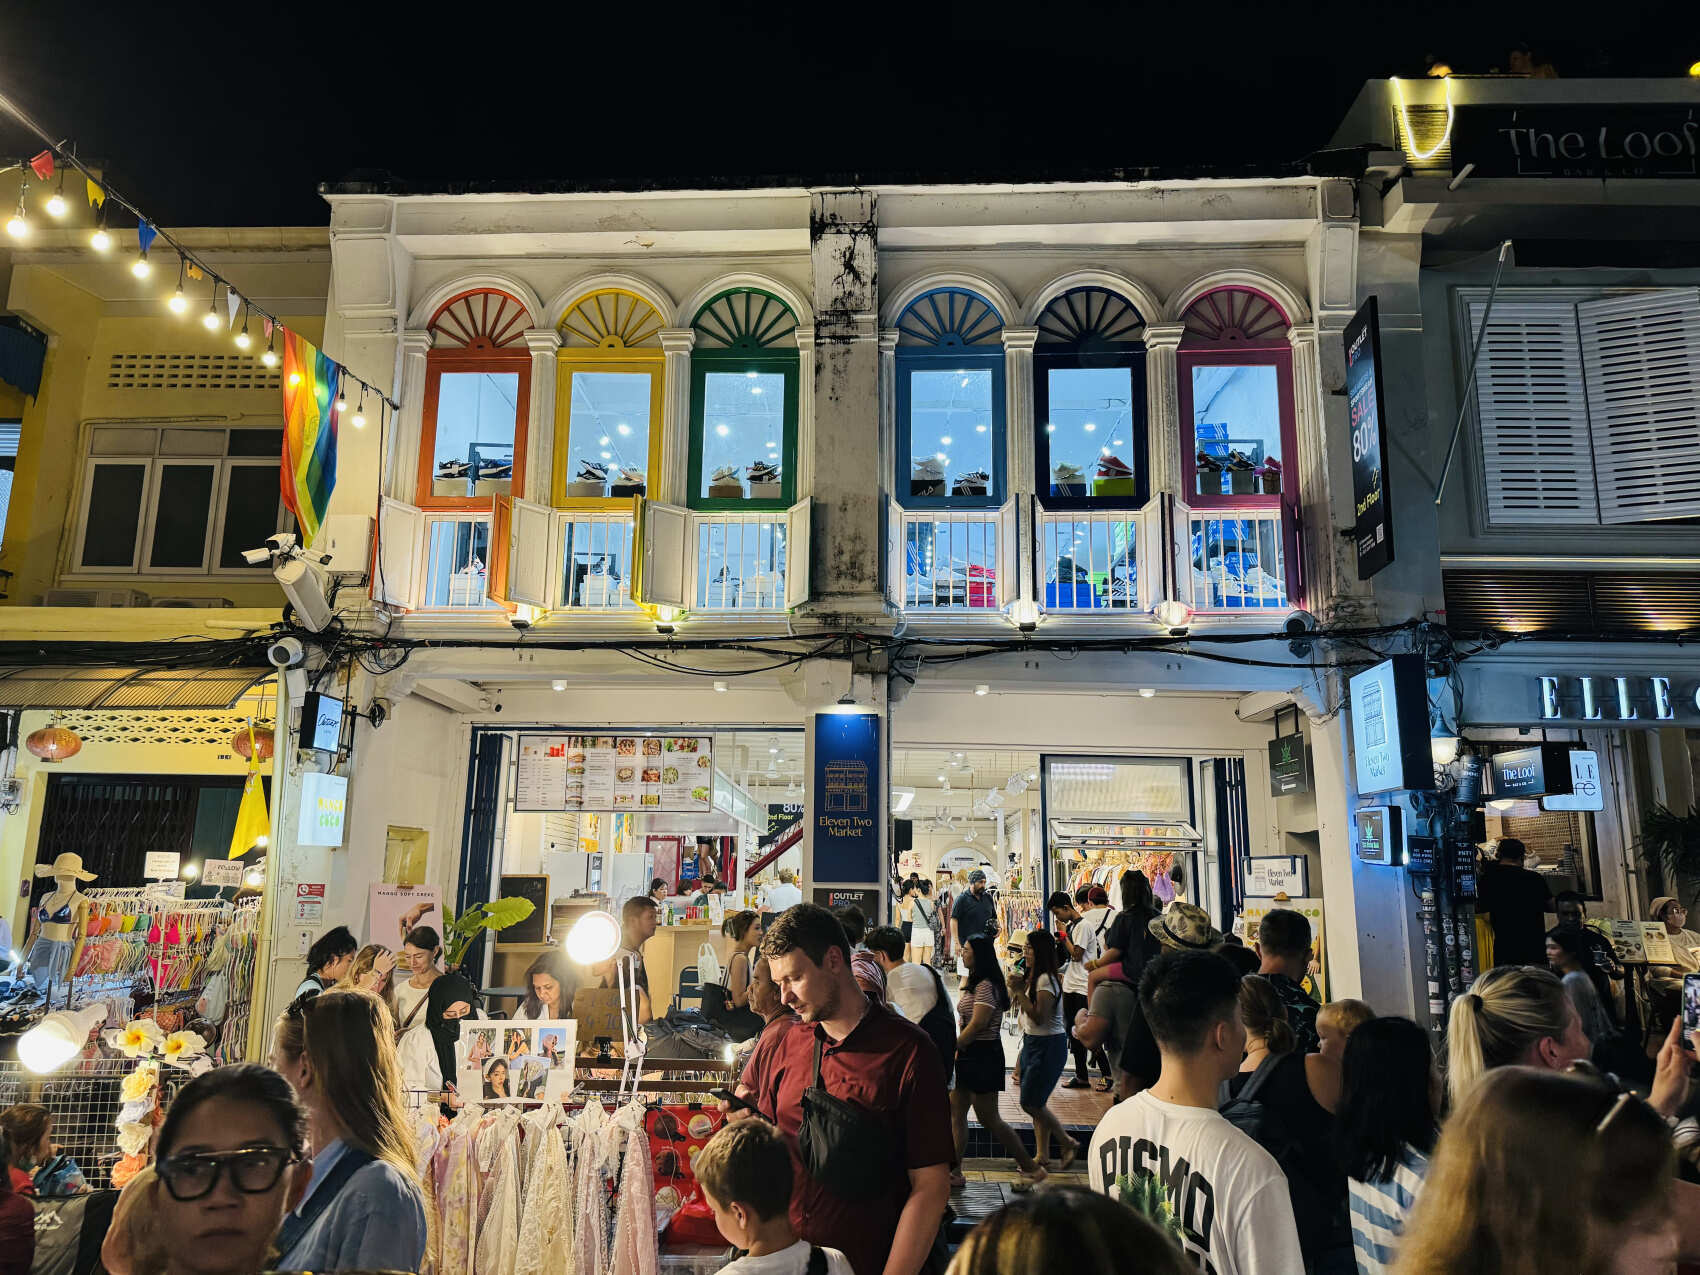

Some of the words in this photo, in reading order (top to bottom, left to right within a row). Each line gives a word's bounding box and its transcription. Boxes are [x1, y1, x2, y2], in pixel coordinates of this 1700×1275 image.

[1498, 127, 1587, 160] The
[1351, 324, 1368, 353] OUTLET
[1352, 390, 1375, 427] SALE
[1353, 415, 1377, 463] 80%
[1357, 497, 1367, 517] 2nd
[1366, 488, 1380, 509] Floor
[1538, 676, 1675, 720] ELLE
[1501, 768, 1517, 780] The
[1518, 764, 1535, 778] Loof
[782, 803, 804, 813] 80%
[819, 816, 850, 827] Eleven
[853, 816, 873, 827] Two
[829, 826, 863, 838] Market
[1267, 868, 1283, 877] Eleven
[1268, 878, 1285, 887] Market
[833, 892, 865, 900] OUTLET
